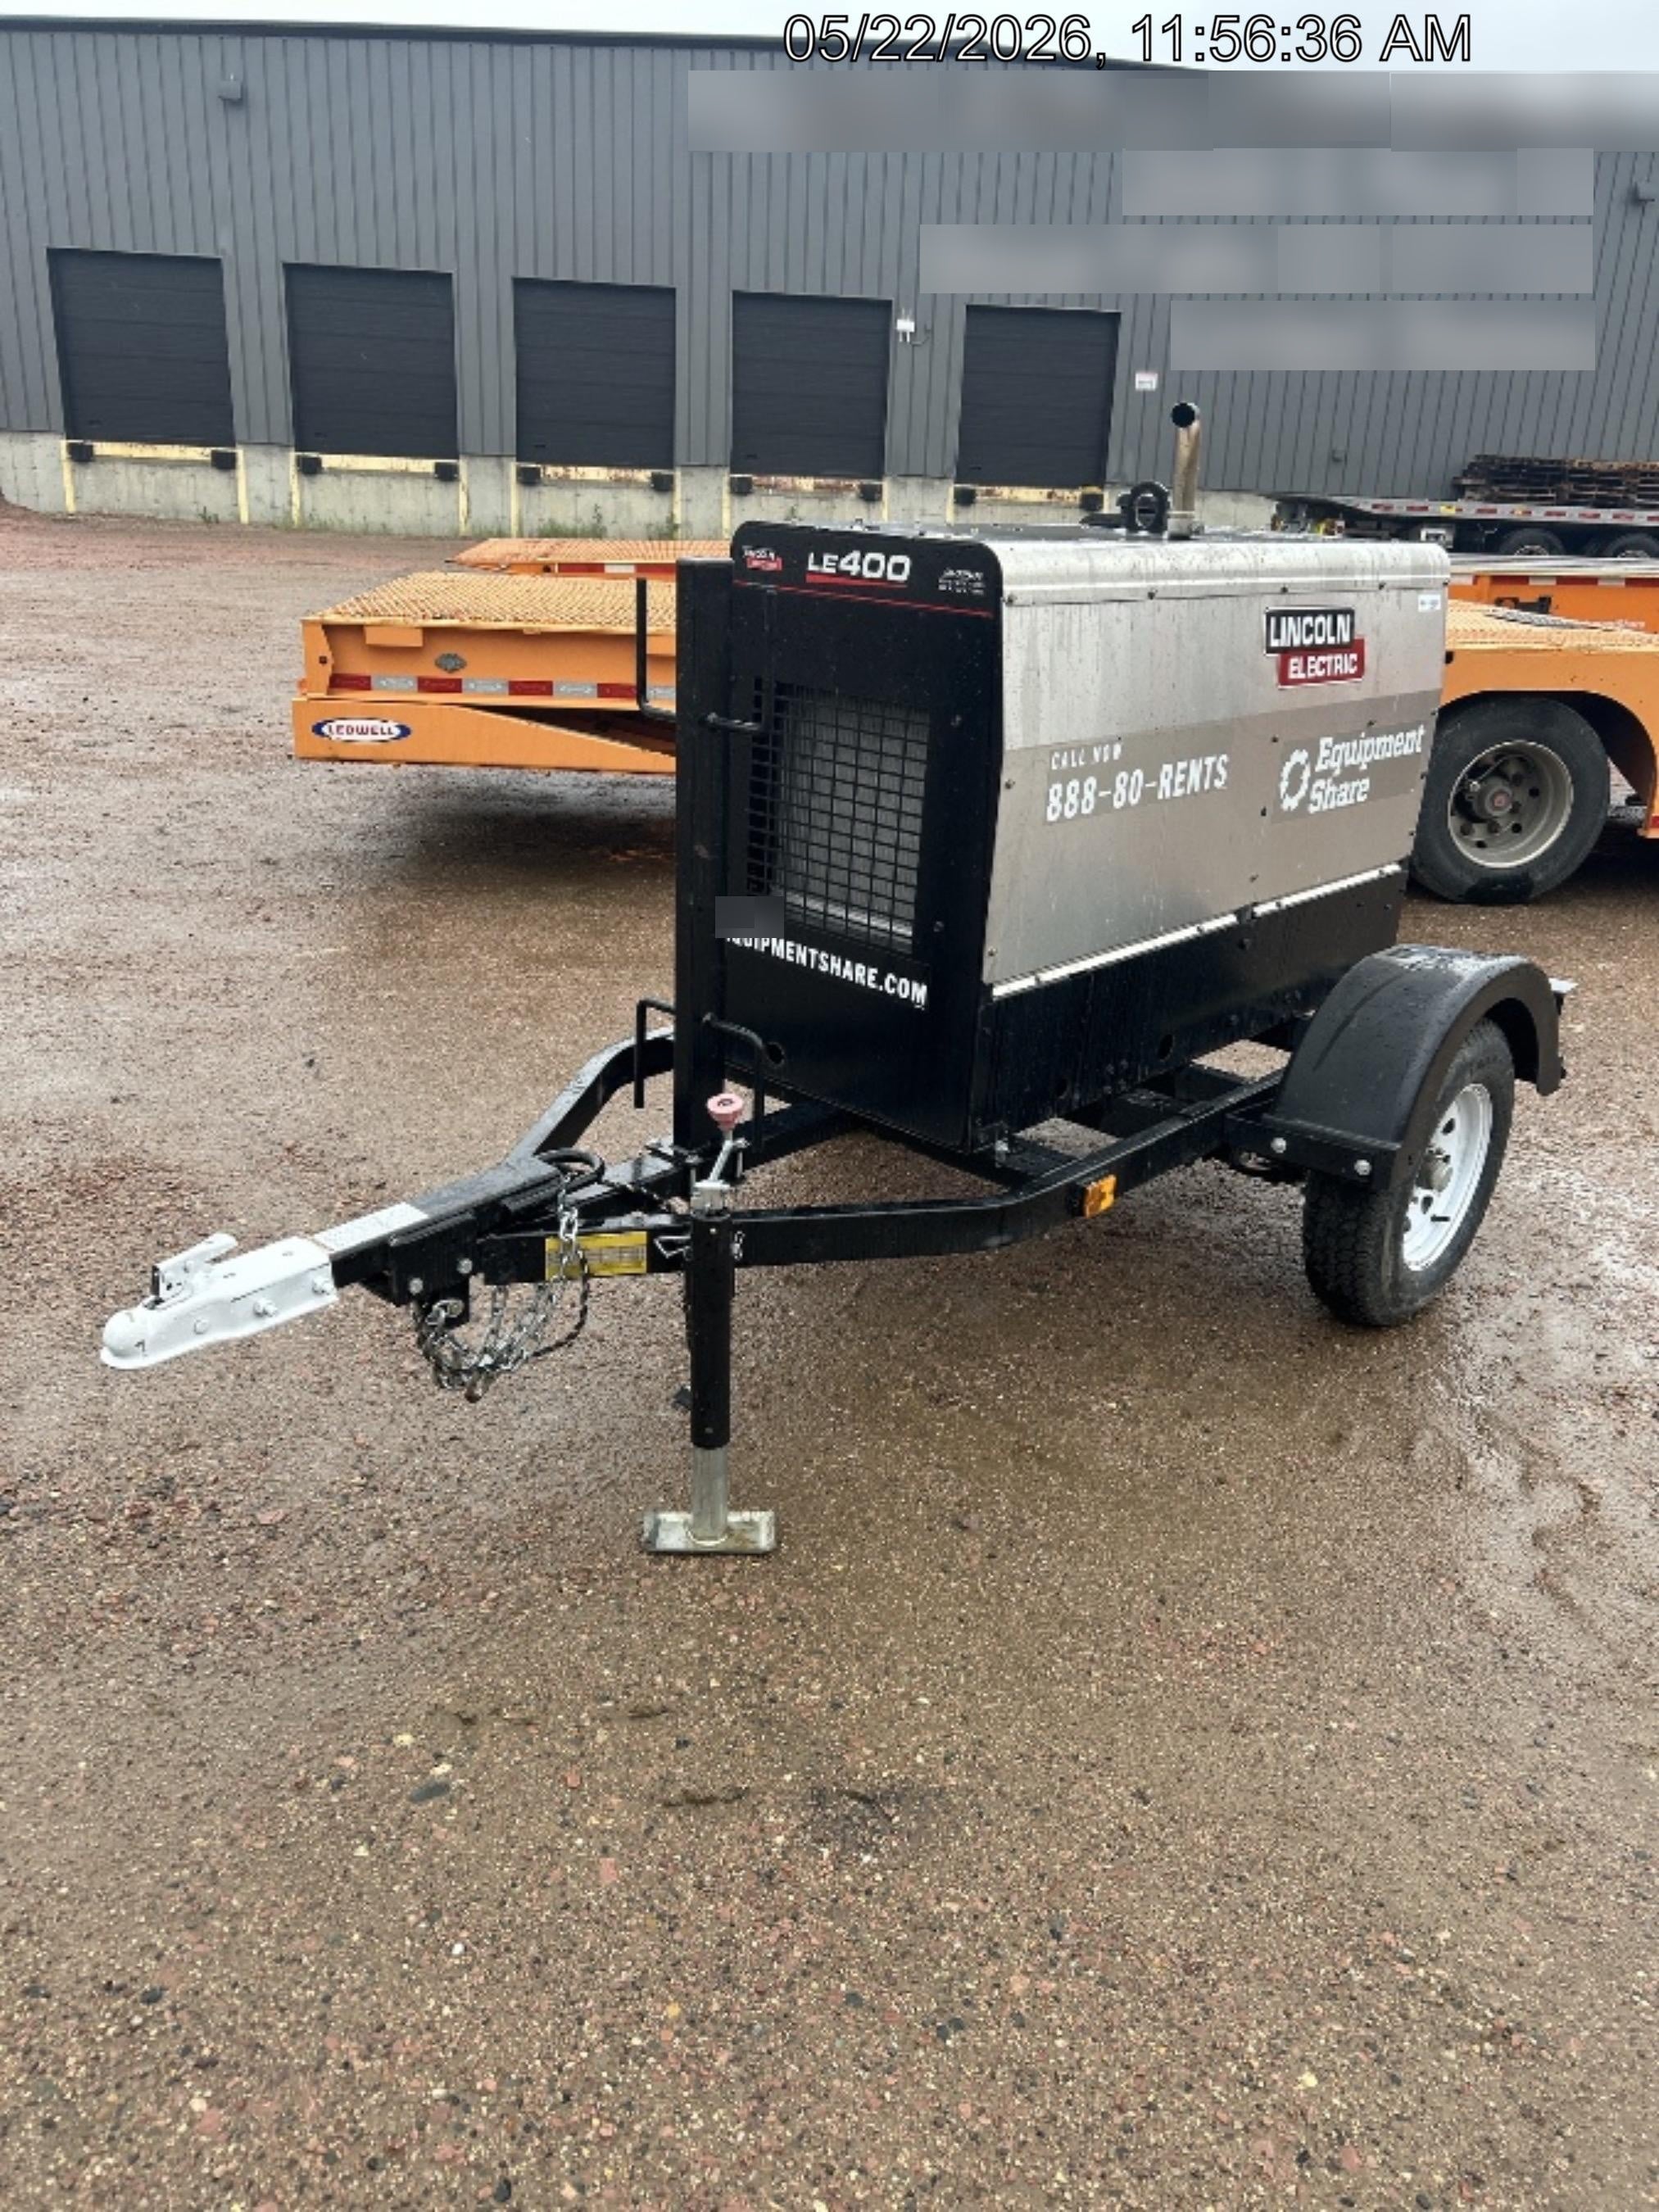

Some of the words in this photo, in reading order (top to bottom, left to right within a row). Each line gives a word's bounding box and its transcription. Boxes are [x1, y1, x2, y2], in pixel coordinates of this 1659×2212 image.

[805, 550, 911, 582] LE400
[1269, 614, 1351, 647] LINCOLN
[1287, 653, 1358, 679] ELECTRIC
[328, 724, 394, 736] LEDWELL
[1314, 723, 1426, 776] Equipment
[1046, 753, 1229, 823] 888-80-RENTS
[1308, 777, 1371, 814] Share
